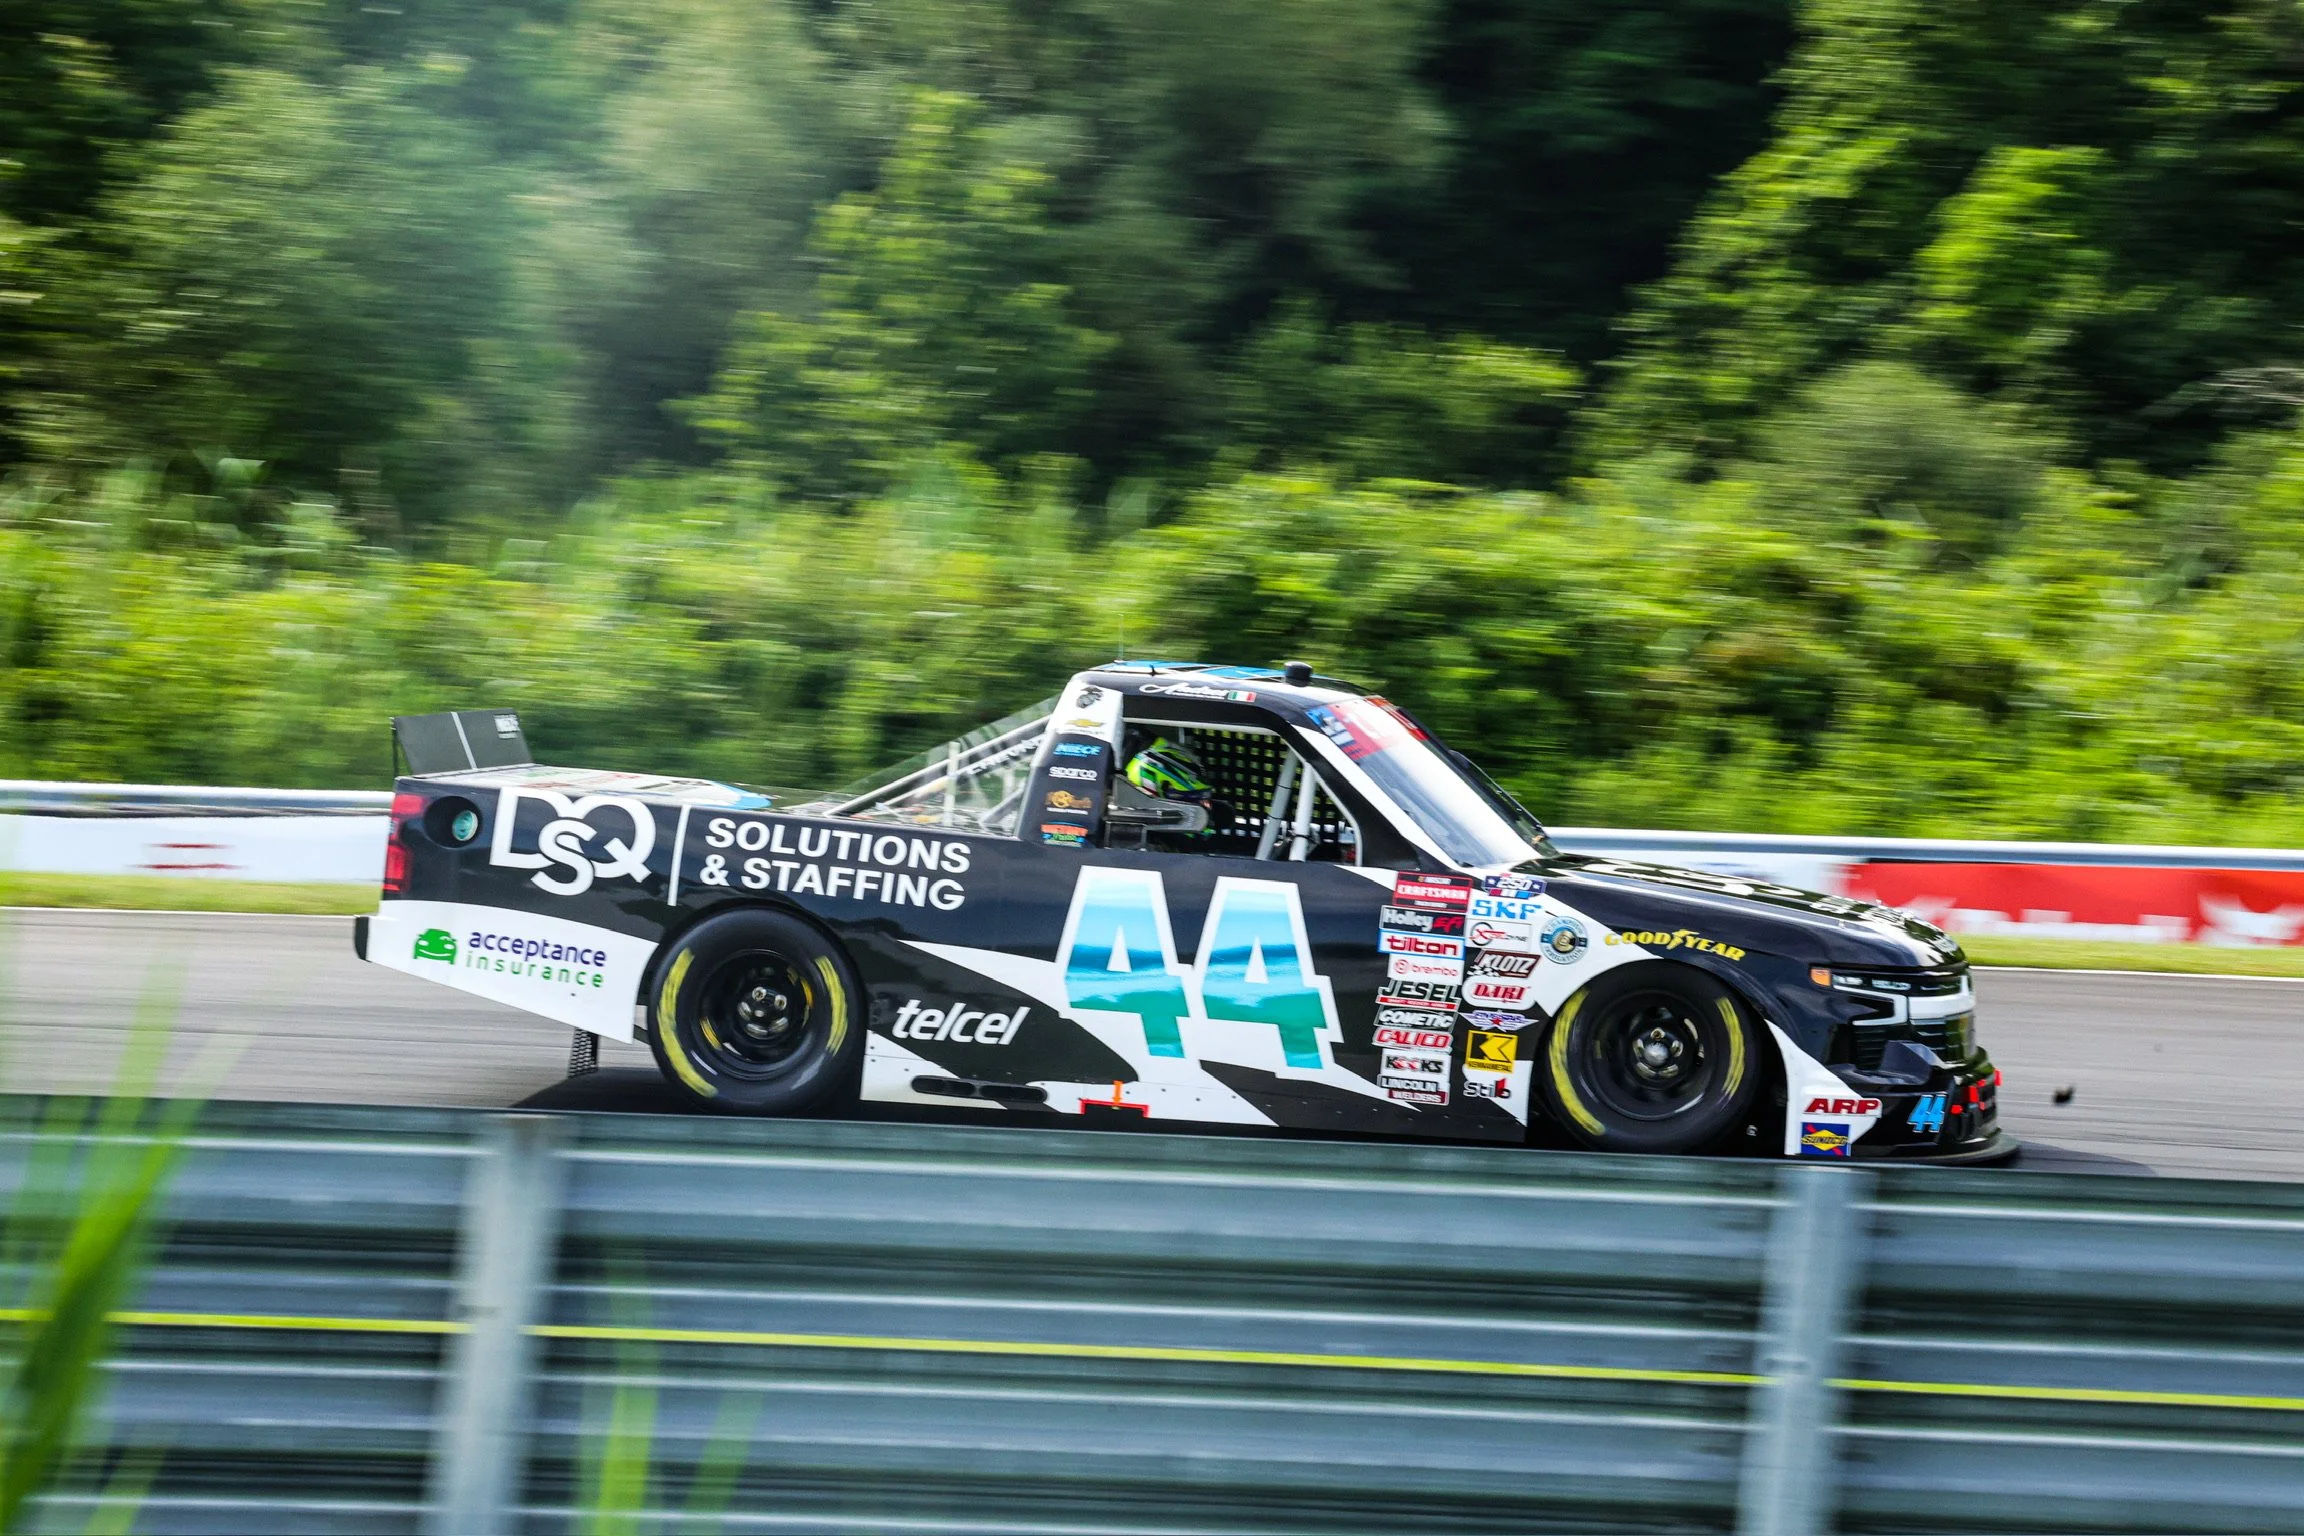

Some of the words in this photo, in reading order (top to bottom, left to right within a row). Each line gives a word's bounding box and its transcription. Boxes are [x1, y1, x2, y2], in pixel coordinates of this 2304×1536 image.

[1049, 766, 1097, 781] sparco
[704, 817, 971, 874] SOLUTIONS
[700, 855, 729, 886] &
[740, 857, 966, 911] STAFFING
[1397, 884, 1468, 900] CRAFTSMAN
[1496, 877, 1533, 892] 250
[1383, 908, 1433, 932] Holley
[1472, 899, 1542, 920] SKF
[469, 931, 606, 967] acceptance
[1387, 936, 1458, 956] tilton
[1605, 929, 1746, 961] GOODYEAR
[465, 950, 604, 988] insurance
[1055, 865, 1344, 1080] 44
[1480, 953, 1536, 974] KLOTZ
[1378, 979, 1462, 1001] JESEL
[892, 999, 1031, 1045] telcel
[1379, 1009, 1454, 1028] COMETIC
[1376, 1029, 1450, 1048] CALICO
[1381, 1076, 1438, 1092] LINCOLN
[1805, 1098, 1879, 1115] ARP
[1907, 1093, 1947, 1134] 44
[1801, 1134, 1849, 1146] SUNOCO
